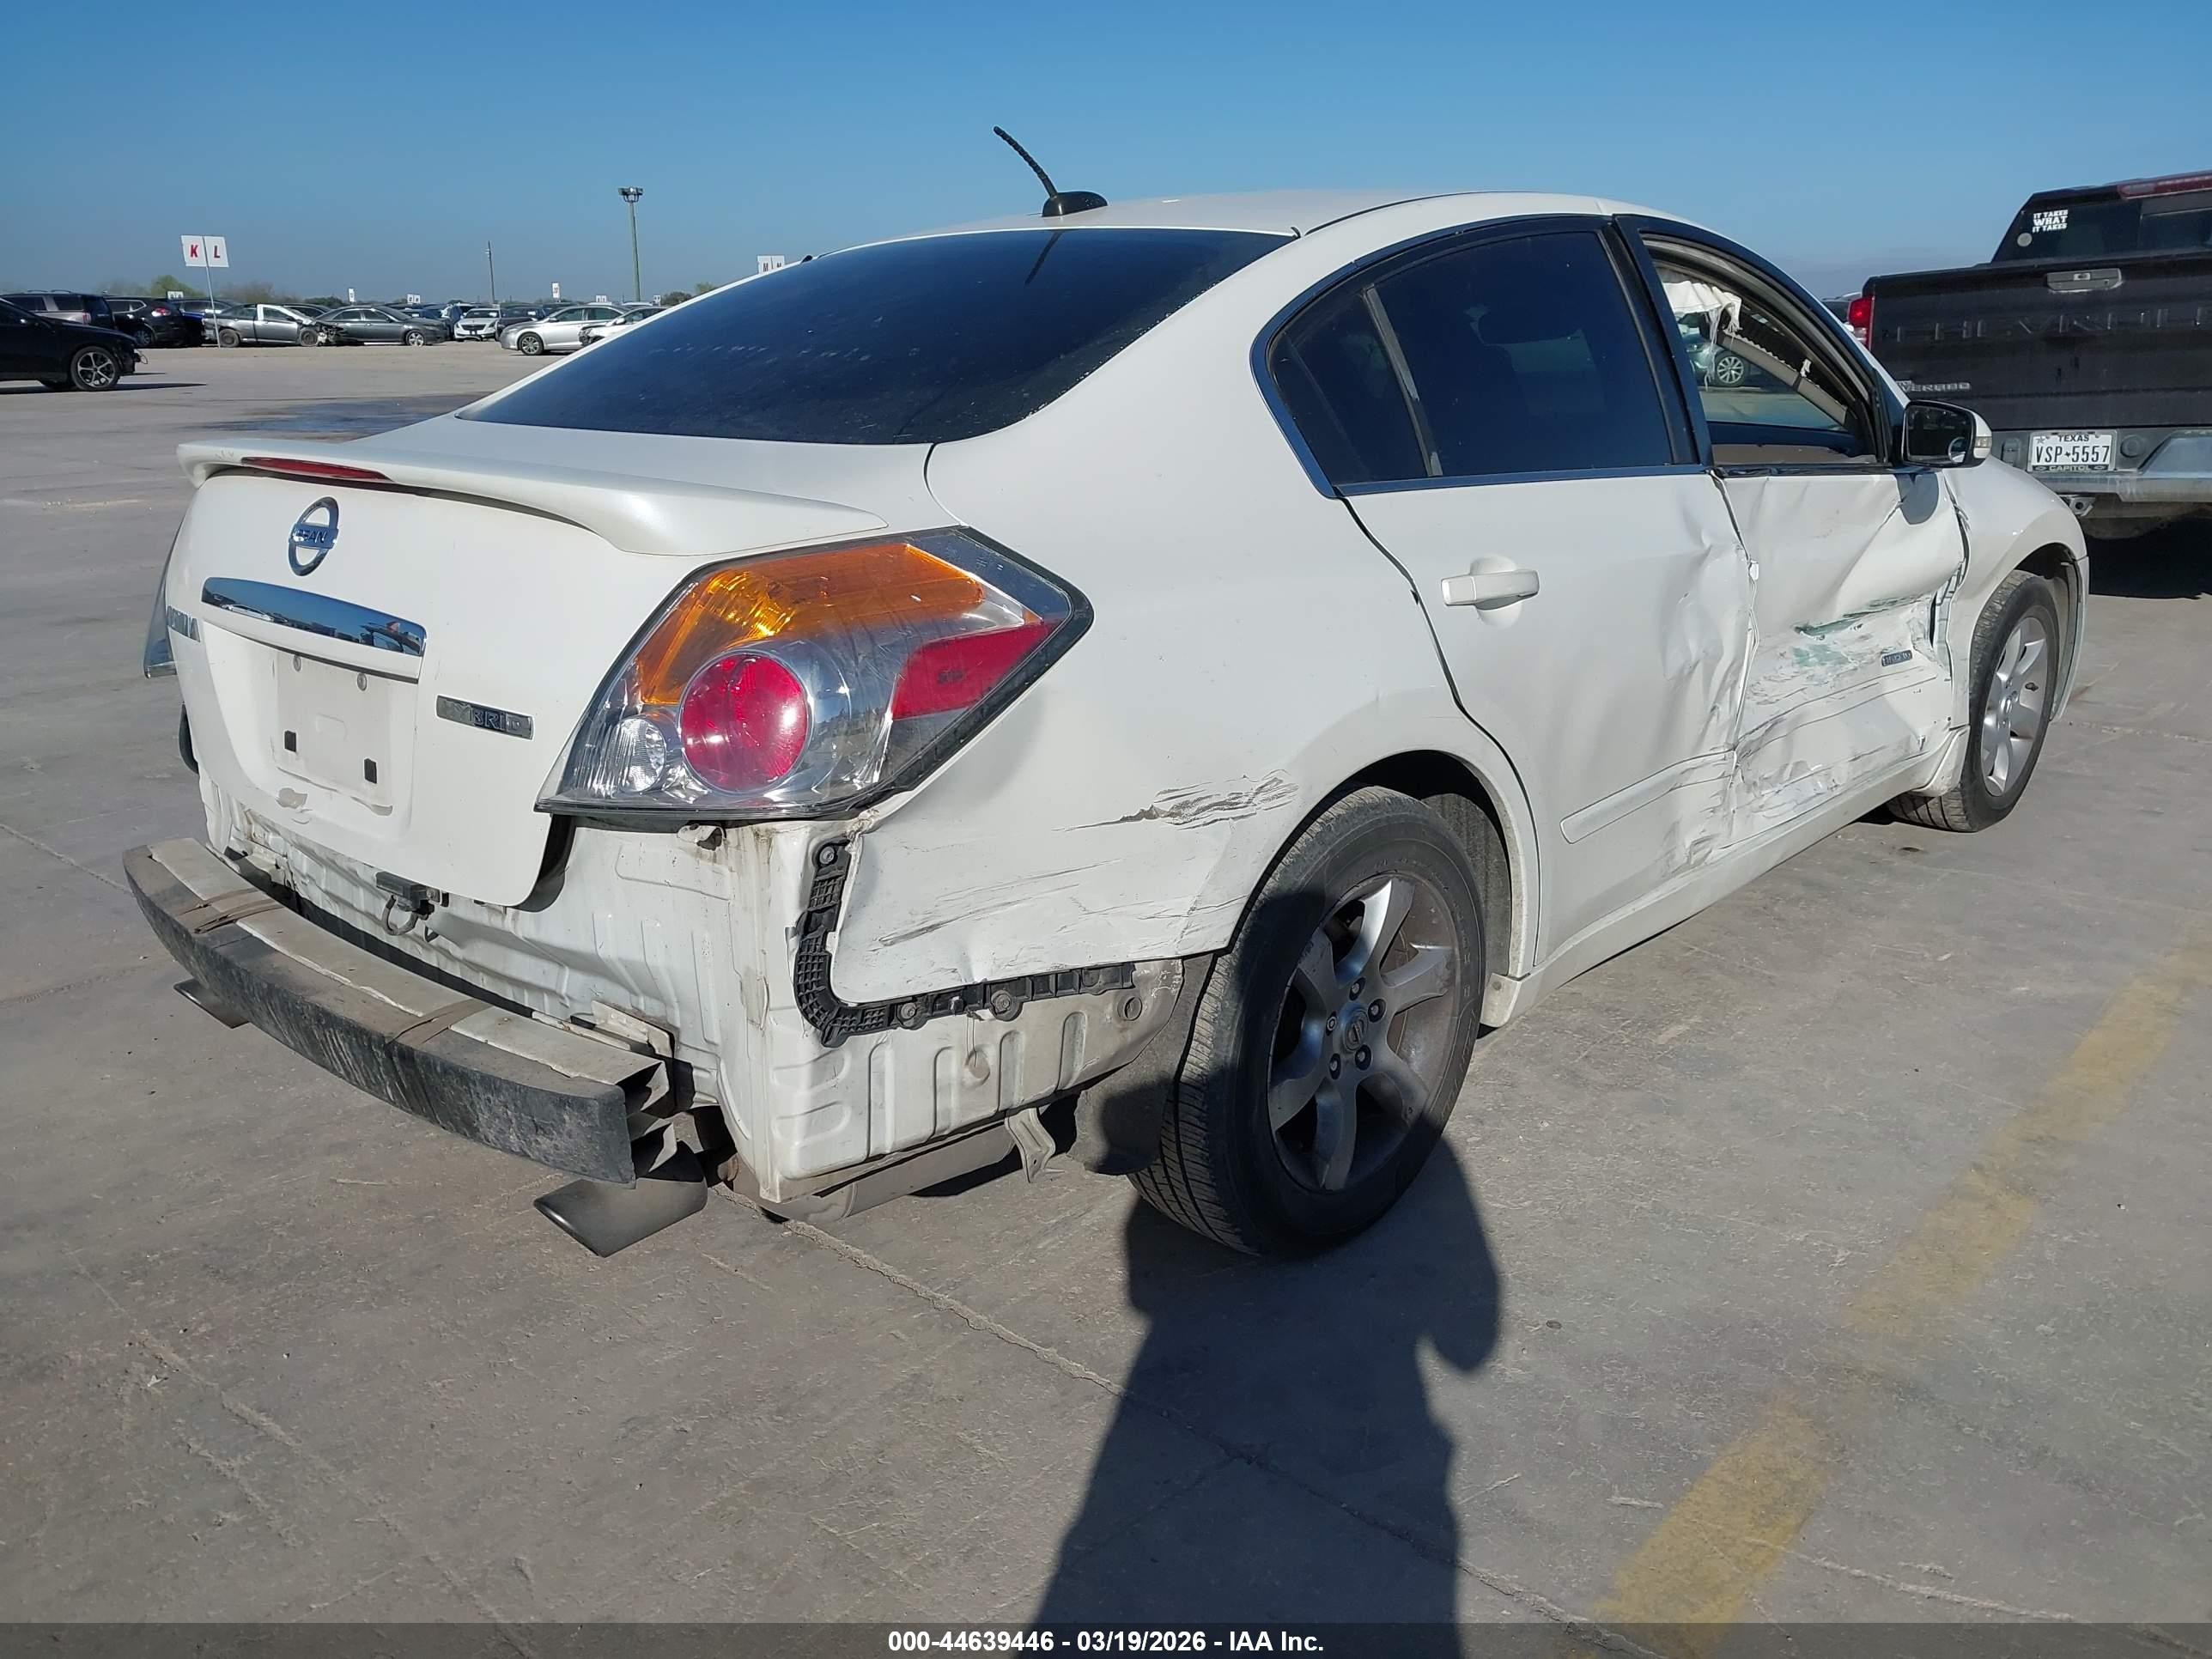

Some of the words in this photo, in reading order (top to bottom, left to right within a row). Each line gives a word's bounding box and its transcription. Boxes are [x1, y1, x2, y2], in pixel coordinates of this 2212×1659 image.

[2033, 216, 2068, 226] WHAT
[191, 244, 198, 258] K
[214, 246, 221, 258] L
[2057, 434, 2089, 442] TEXAS
